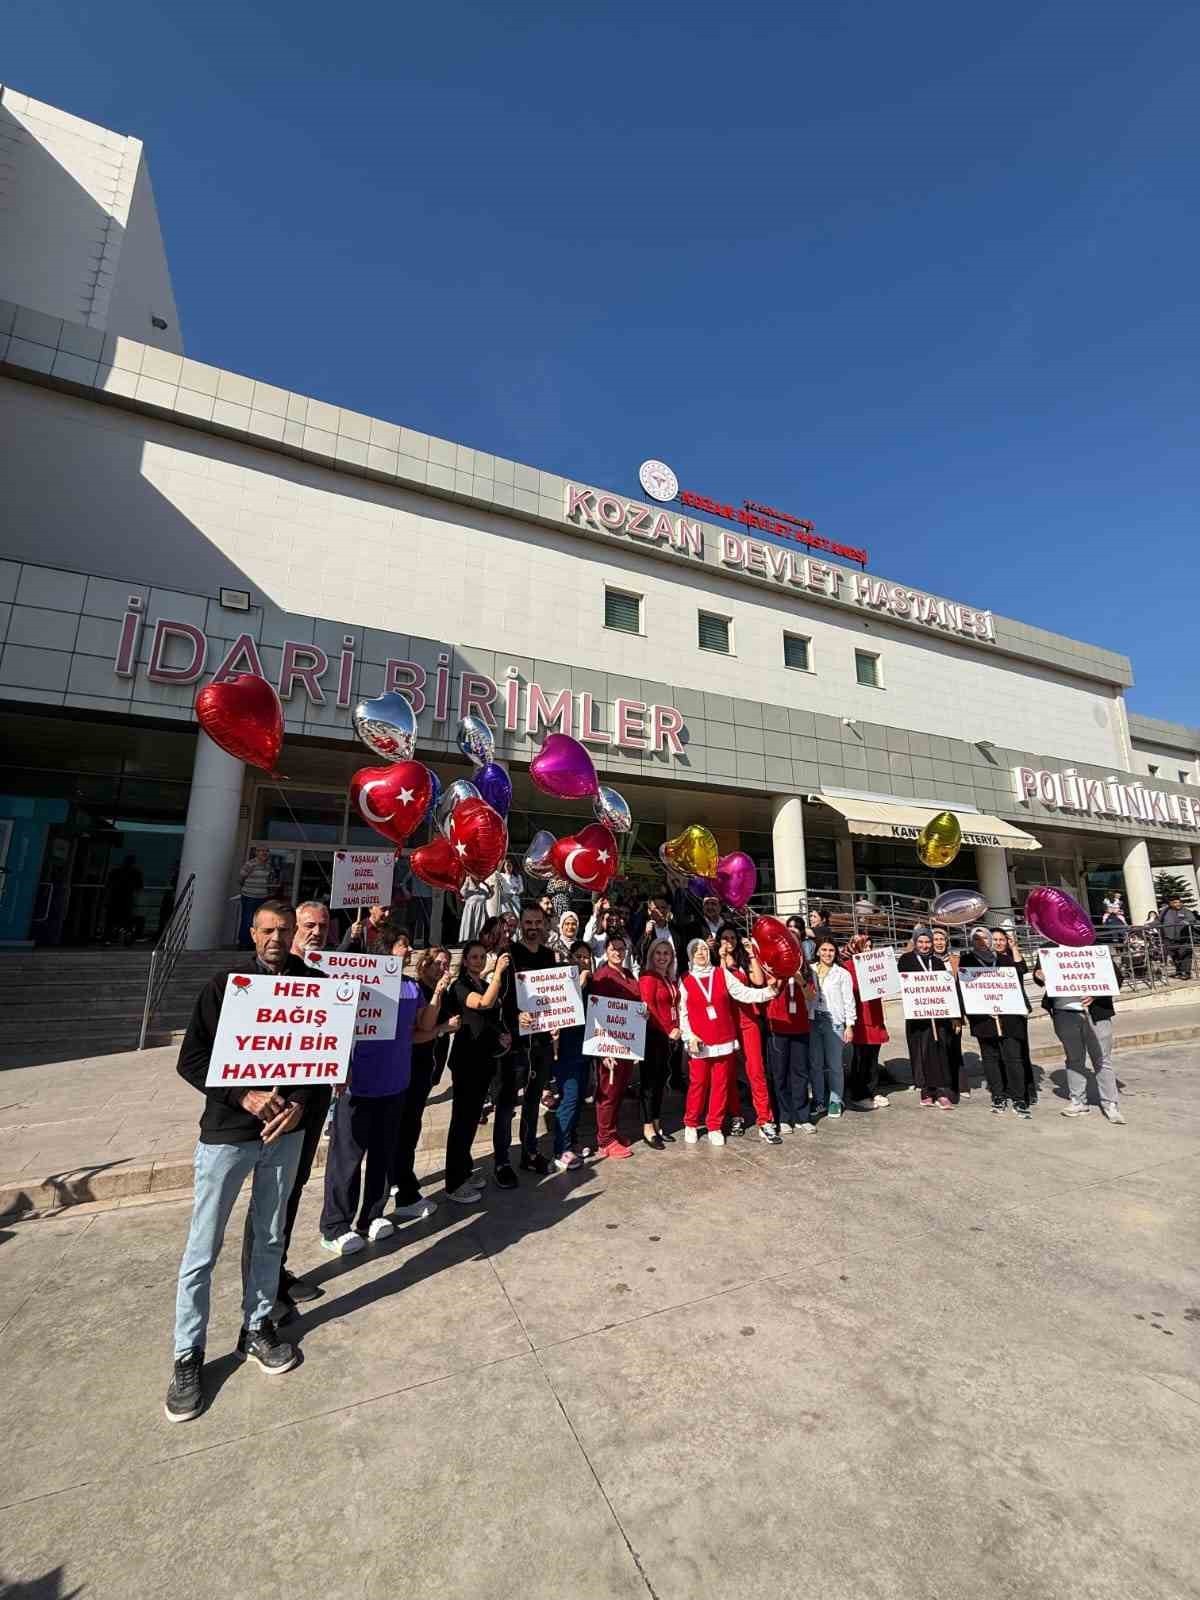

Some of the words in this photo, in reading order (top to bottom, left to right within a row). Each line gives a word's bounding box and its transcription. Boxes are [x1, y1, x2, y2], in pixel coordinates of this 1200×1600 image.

[566, 483, 701, 553] KOZAN
[720, 531, 842, 593] DEVLET
[851, 574, 995, 639] HASTANESİ
[114, 595, 354, 709] İDARİ
[384, 653, 686, 755] BİRİMLER
[328, 955, 378, 968] BUGÜN
[1056, 950, 1093, 958] ORGAN
[1059, 961, 1095, 970] BAĞIŞI
[1062, 973, 1096, 981] HAYAT
[273, 982, 321, 998] HER
[255, 1006, 328, 1028] BAĞIŞ
[235, 1032, 292, 1051] YENİ
[300, 1032, 338, 1051] BİR
[221, 1063, 339, 1080] HAYATTIR
